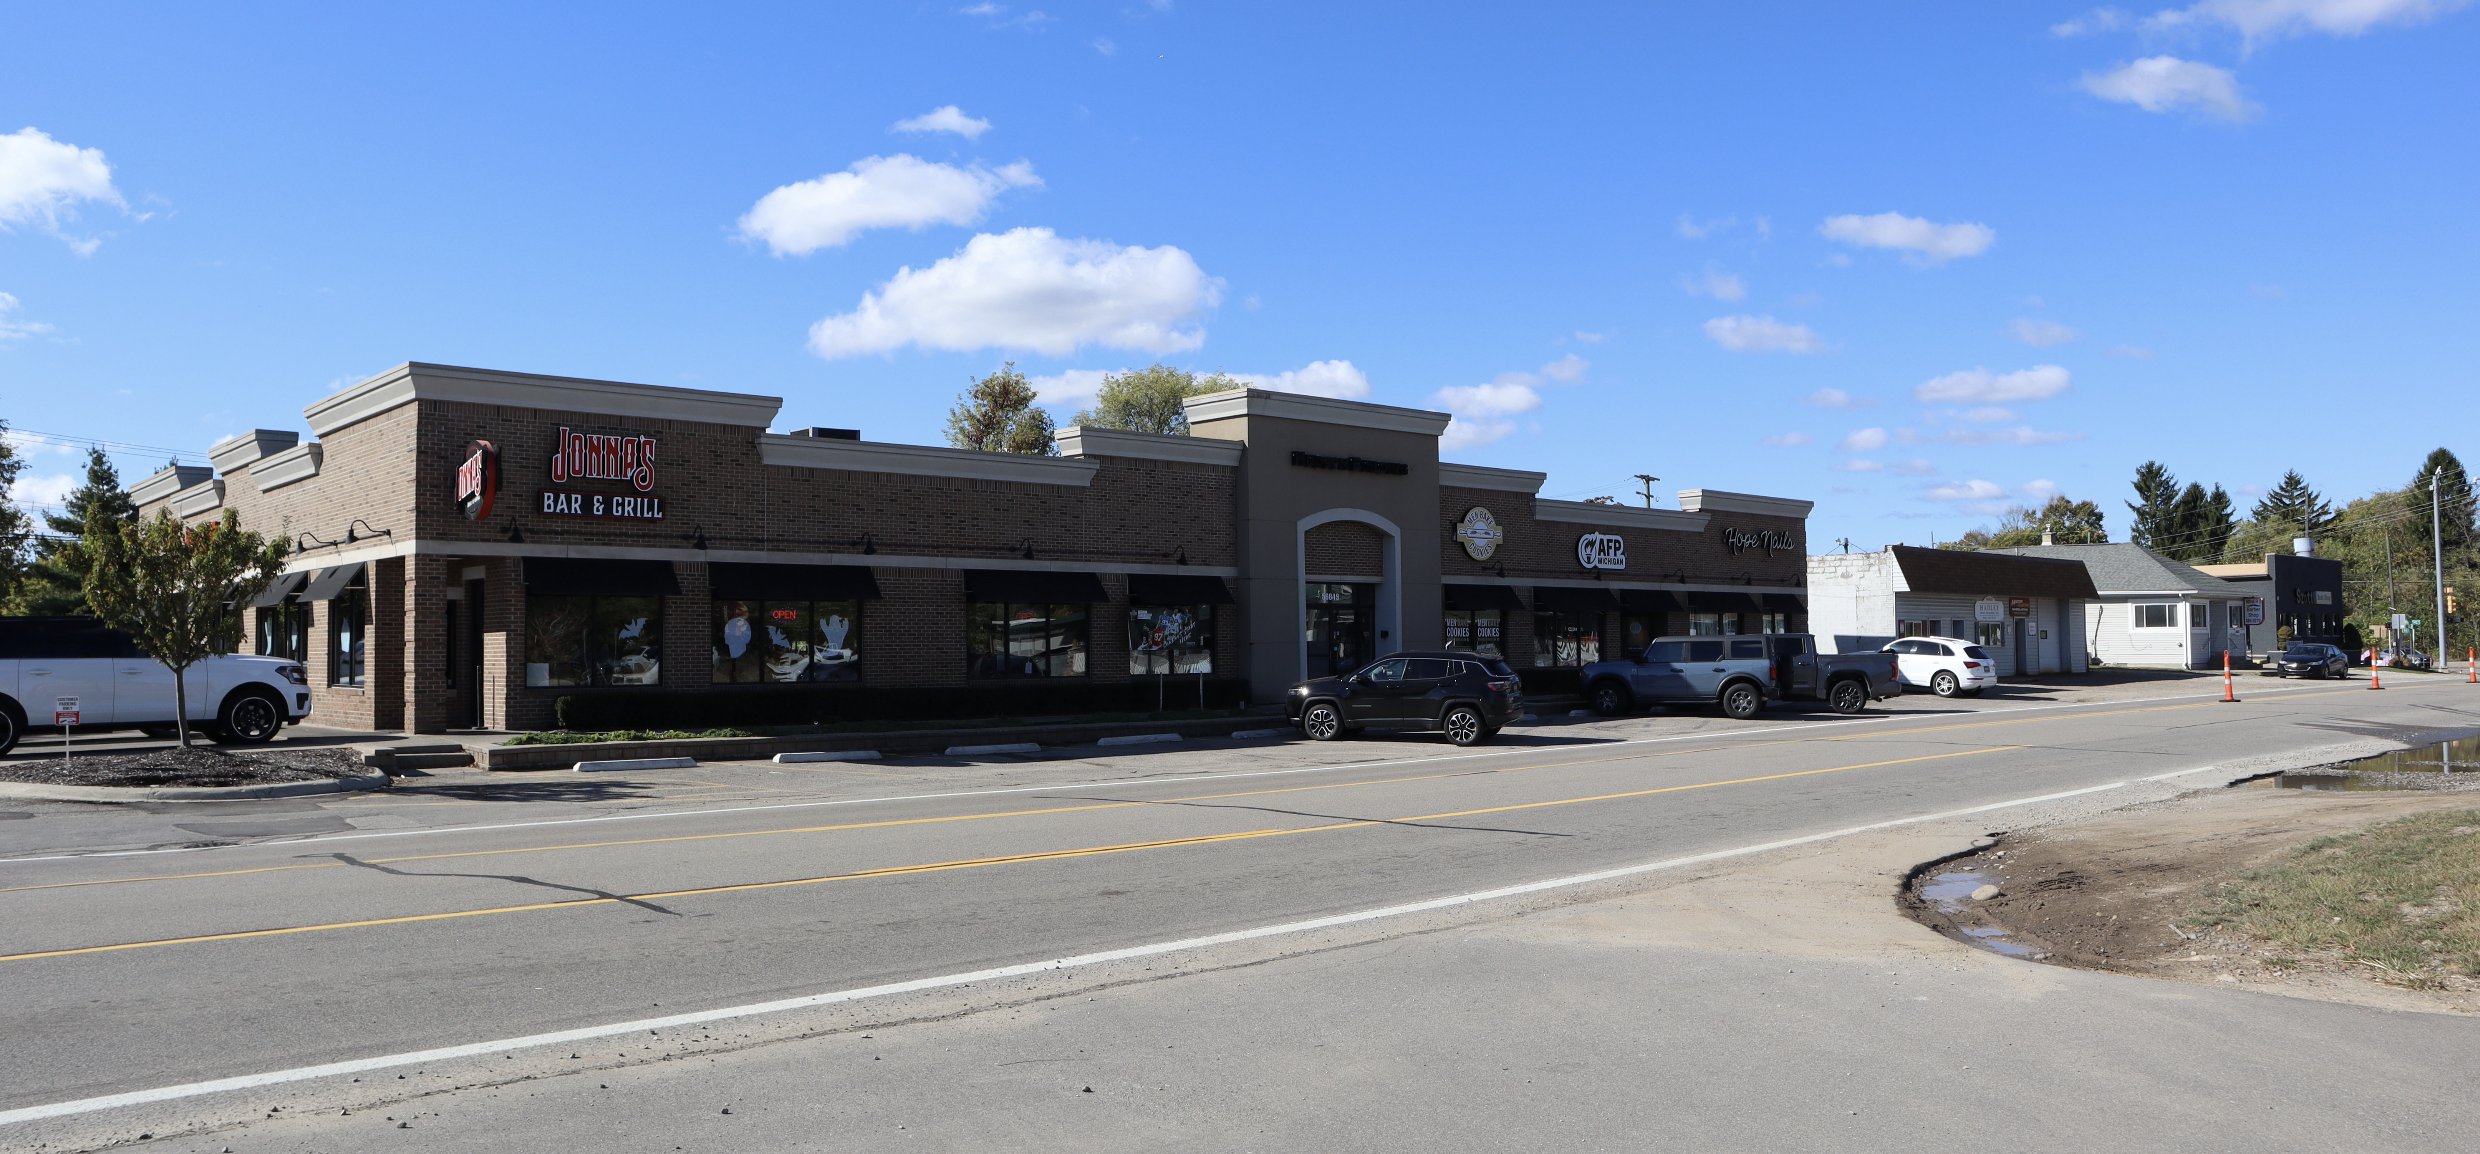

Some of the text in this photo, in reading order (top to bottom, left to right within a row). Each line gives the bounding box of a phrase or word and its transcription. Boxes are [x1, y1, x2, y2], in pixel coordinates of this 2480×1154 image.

[551, 427, 656, 491] JONNA'S
[543, 492, 663, 518] BAR & GRILL
[1467, 510, 1494, 527] MEN BAKE
[1469, 542, 1492, 557] COOKIES
[1598, 538, 1622, 557] AFP
[1725, 527, 1796, 558] Hope Nails
[1597, 556, 1624, 566] MICHIGAN
[772, 609, 797, 619] OPEN
[1446, 627, 1470, 637] COOKIES
[1477, 627, 1500, 637] COOKIES
